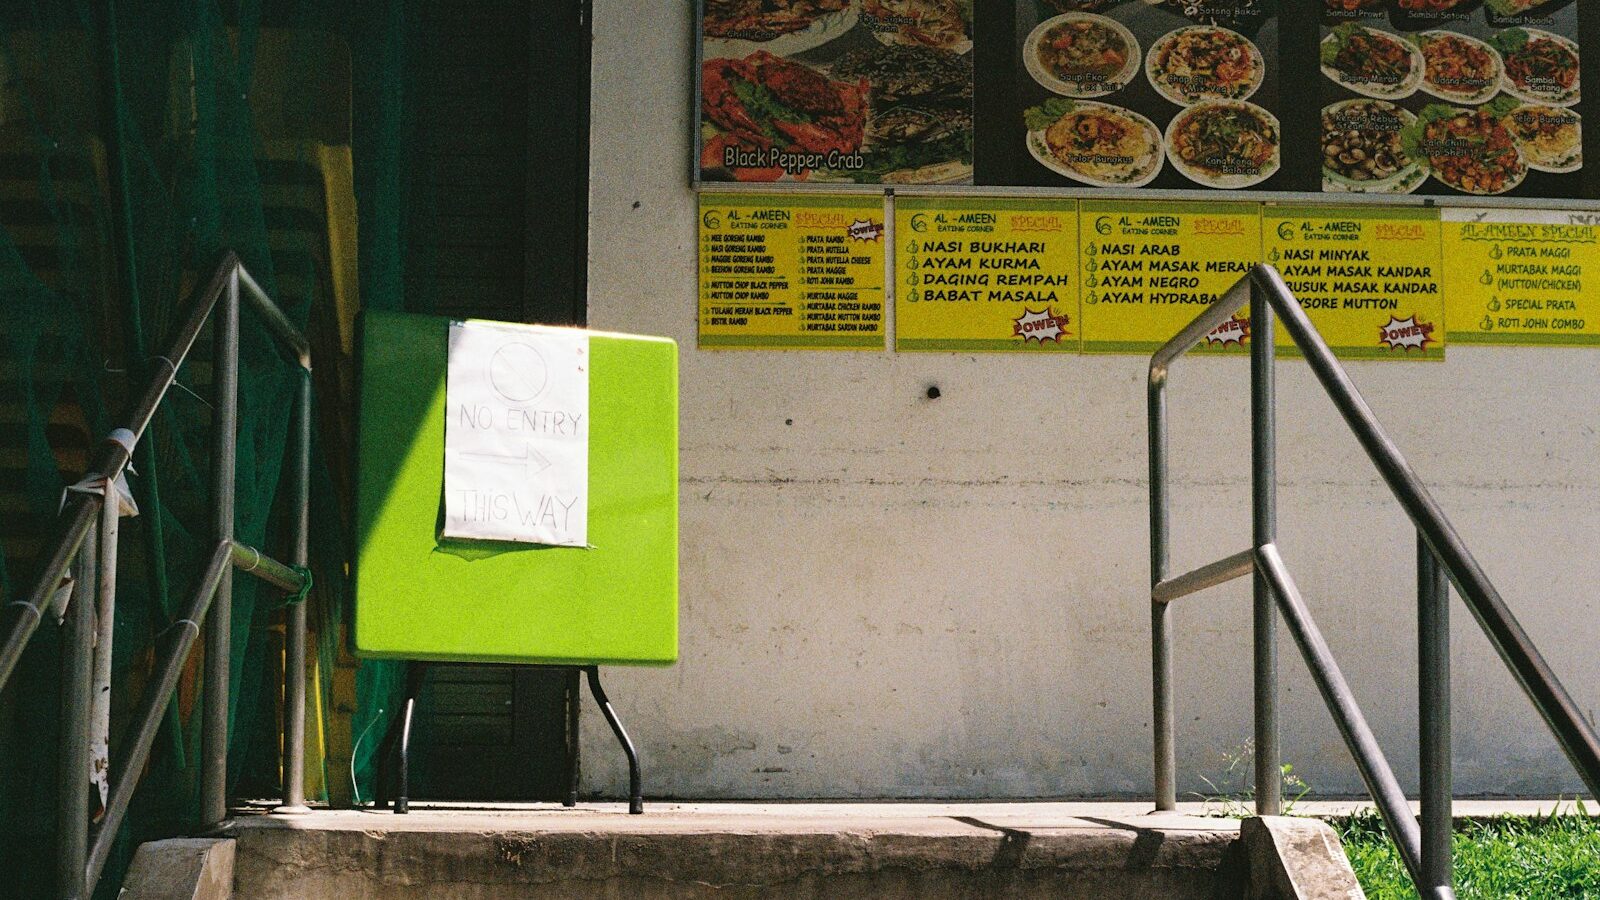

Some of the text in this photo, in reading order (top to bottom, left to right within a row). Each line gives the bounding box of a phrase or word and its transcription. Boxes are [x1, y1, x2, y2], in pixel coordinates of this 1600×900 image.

[1234, 7, 1262, 16] Bakar
[1326, 9, 1384, 19] Sambal Prawn
[1408, 10, 1439, 20] Sambal
[1492, 16, 1555, 25] Sambal Noodle
[1060, 72, 1108, 83] Soup Ekor
[1524, 75, 1556, 84] Sambal
[1370, 114, 1399, 123] Rebus
[1540, 114, 1576, 125] Bungkus
[724, 147, 865, 174] Black Pepper Crab
[1095, 154, 1134, 166] Bungkus
[1205, 156, 1252, 167] Kang Kong
[728, 210, 741, 220] AL
[934, 214, 948, 224] AL
[730, 222, 788, 230] EATING CORNER
[1118, 216, 1132, 226] AL
[1300, 221, 1314, 231] AL
[1461, 224, 1597, 240] AL-AMEEN SPECIAL
[711, 234, 766, 242] MEE GORENG RAMBO
[807, 236, 845, 244] PRATA RAMBO
[711, 245, 766, 253] NASI GORENG RAMBO
[807, 246, 849, 254] PRATA NUTELLA
[923, 242, 1045, 254] NASI BUKHARI
[1101, 244, 1180, 256] NASI ARAB
[1507, 247, 1571, 259] PRATA MAGGI
[711, 255, 774, 264] MAGGIE GORENG RAMBO
[1284, 249, 1370, 261] NASI MINYAK
[807, 256, 871, 265] PRATA NUTELLA CHEESE
[922, 258, 1041, 270] AYAM KURMA
[734, 266, 755, 274] GORENG
[756, 266, 776, 274] RAMBO
[807, 266, 846, 275] PRATA MAGGIE
[1101, 260, 1257, 273] AYAM MASAK MERAH
[1497, 264, 1582, 276] MURTABAK MAGGI
[1284, 266, 1432, 278] AYAM MASAK KANDAR
[807, 277, 855, 285] ROTI JOHN RAMBO
[923, 274, 1068, 286] DAGING REMPAH
[1101, 276, 1200, 288] AYAM NEGRO
[711, 282, 789, 290] MUTTON CHOP BLACK PEPPER
[1286, 282, 1438, 294] RUSUK MASAK KANDAR
[1497, 279, 1582, 292] (MUTTON/CHICKEN)
[711, 292, 770, 300] MUTTON CHOP RAMBO
[807, 292, 858, 300] MURTABAK MAGGIE
[924, 290, 1059, 302] BABAT MASALA
[1101, 292, 1144, 304] AYAM
[807, 303, 881, 311] MURTABAK CHICKEN RAMBO
[1297, 298, 1398, 310] YSORE MUTTON
[1505, 299, 1576, 311] SPECIAL PRATA
[711, 307, 793, 316] TULANG MERAH BLACK PEPPER
[729, 318, 748, 326] RAMBO
[807, 313, 881, 321] MURTABAK MUTTON RAMBO
[807, 324, 836, 332] MURTABAK
[859, 324, 878, 332] RAMBO
[1498, 318, 1585, 330] ROTI JOHN COMBO
[460, 404, 583, 436] NO ENTRY
[513, 490, 579, 532] WAY
